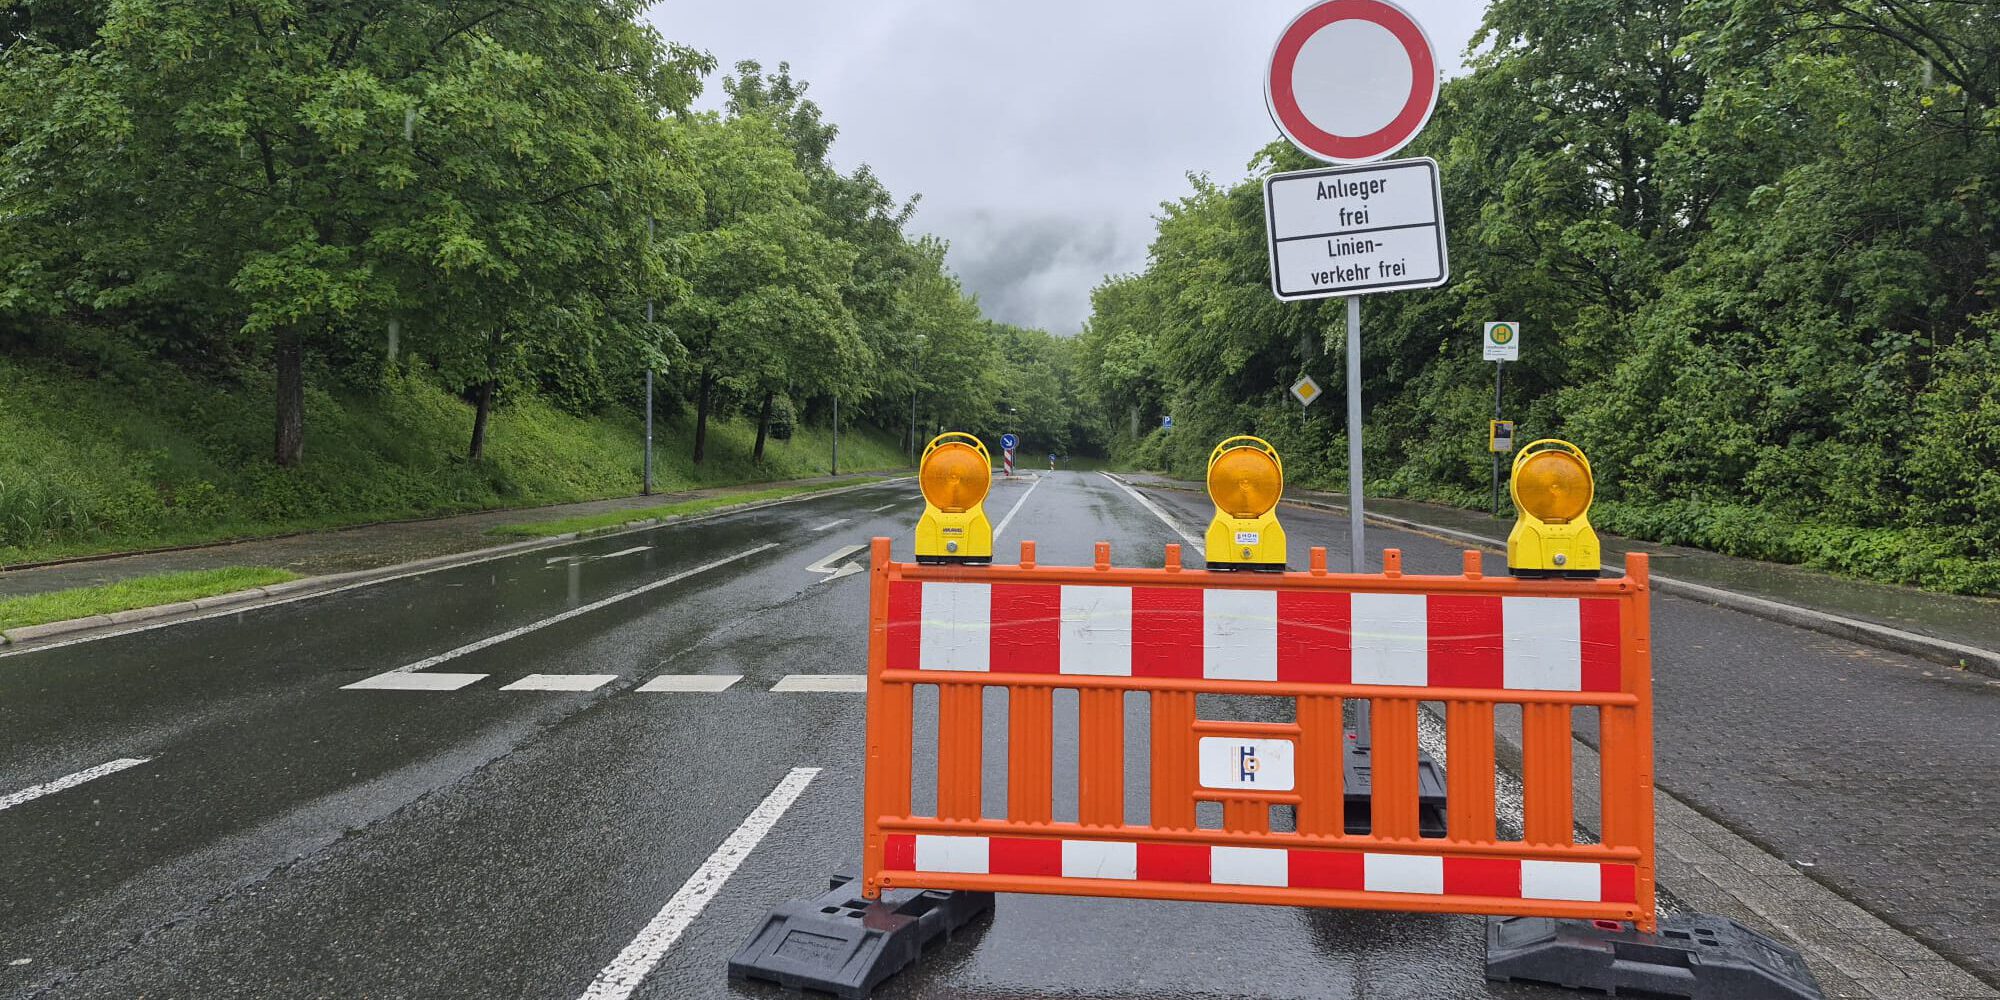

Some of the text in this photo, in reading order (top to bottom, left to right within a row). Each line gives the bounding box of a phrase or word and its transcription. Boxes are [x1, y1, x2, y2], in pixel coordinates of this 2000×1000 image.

[1339, 205, 1369, 226] frei
[1327, 237, 1383, 257] Linien-
[1311, 258, 1406, 285] verkehr frei
[1496, 328, 1506, 340] H
